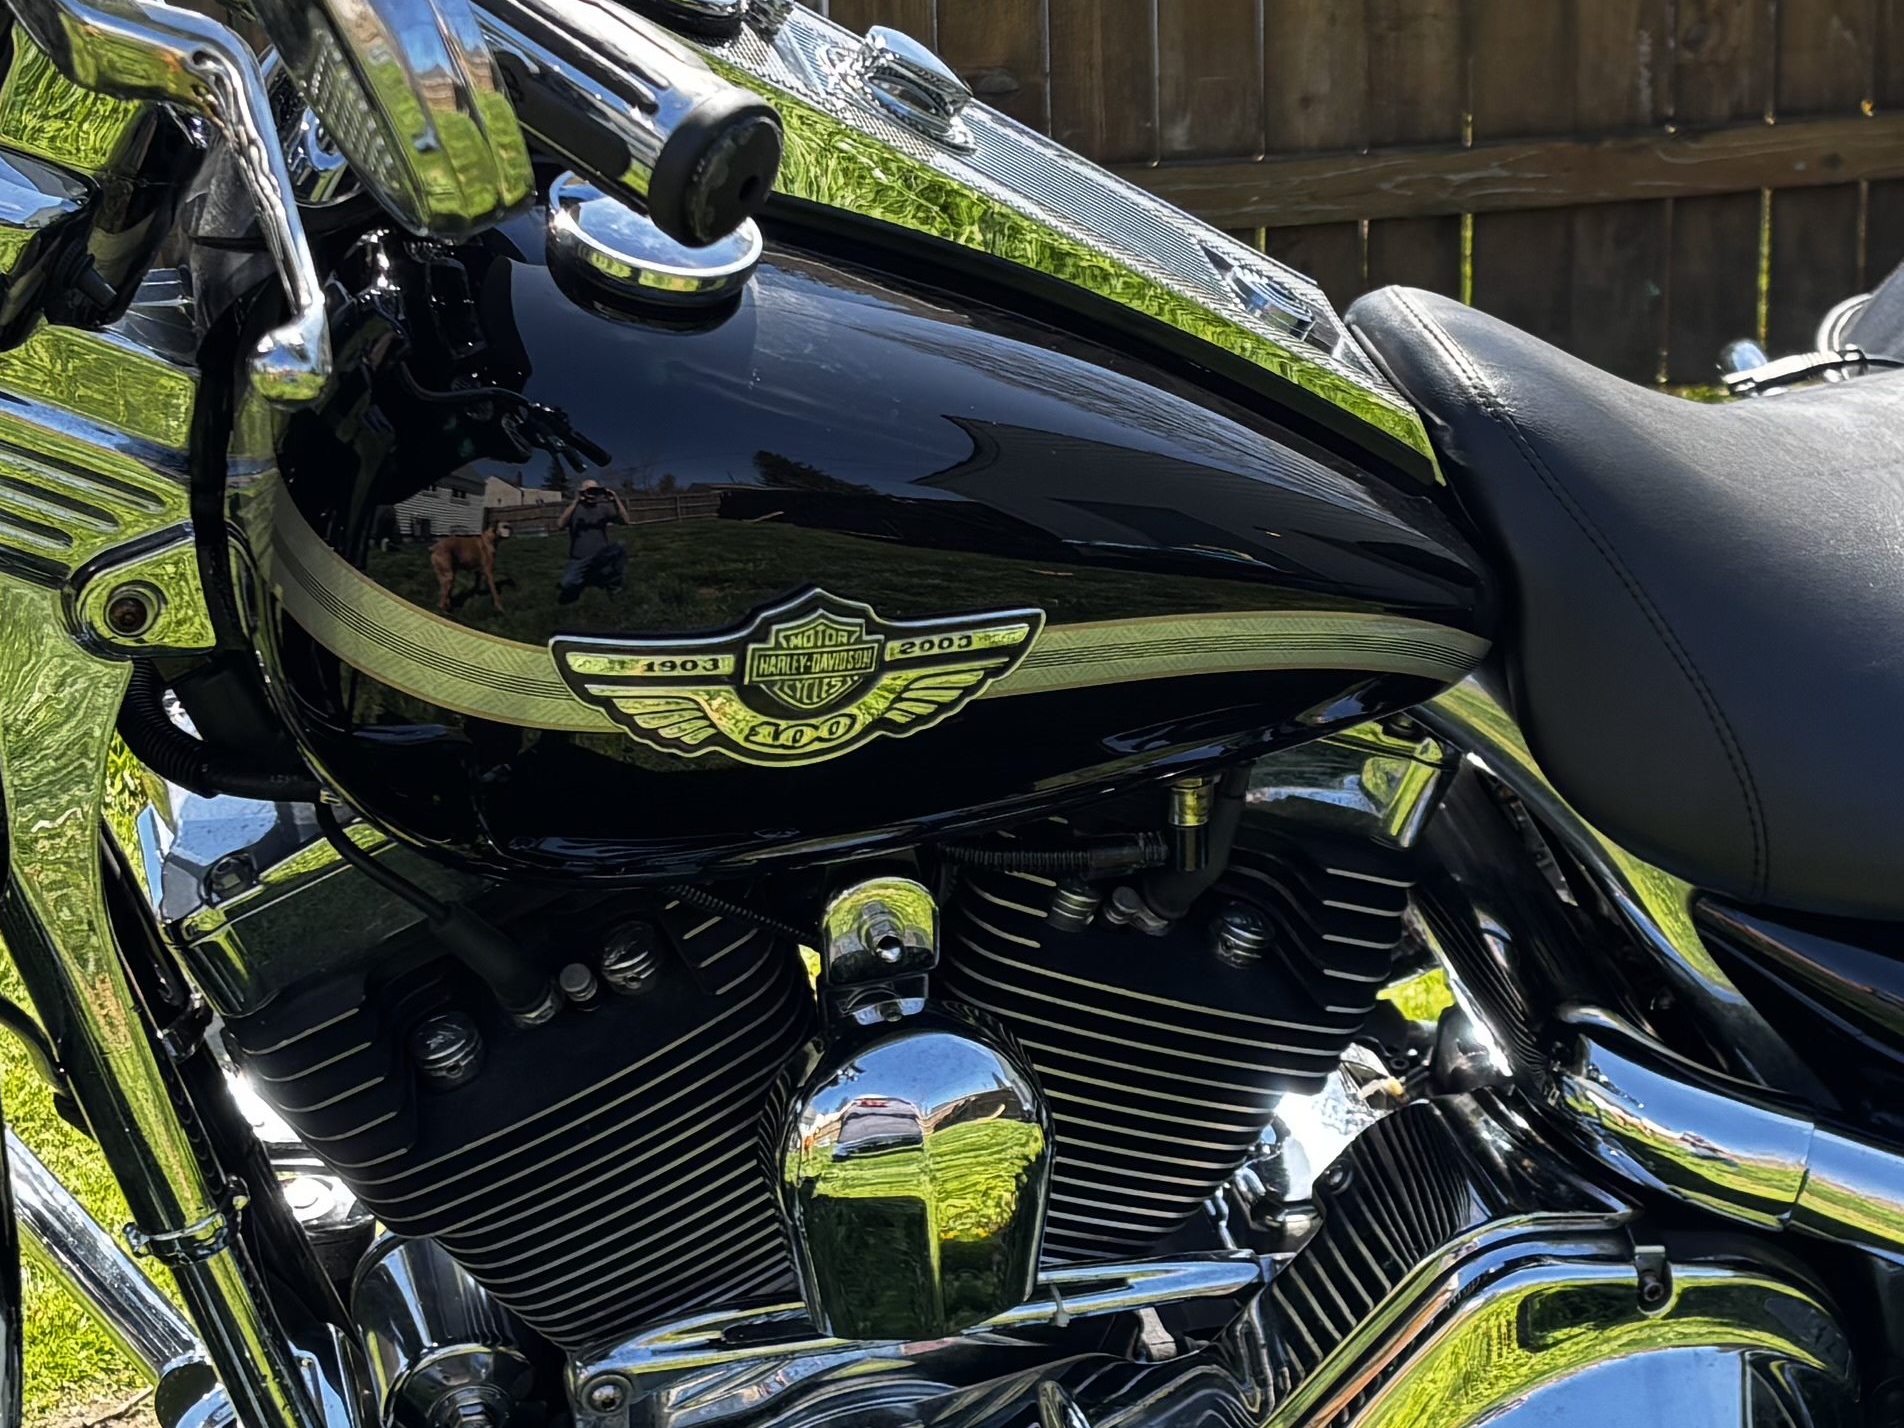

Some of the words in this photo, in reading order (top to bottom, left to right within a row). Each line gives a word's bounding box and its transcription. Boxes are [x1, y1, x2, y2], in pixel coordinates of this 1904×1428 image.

[789, 624, 848, 648] MOTOR
[899, 635, 973, 655] 2003
[643, 658, 720, 673] 1903
[783, 678, 843, 703] CYCLES
[743, 713, 858, 750] 100
